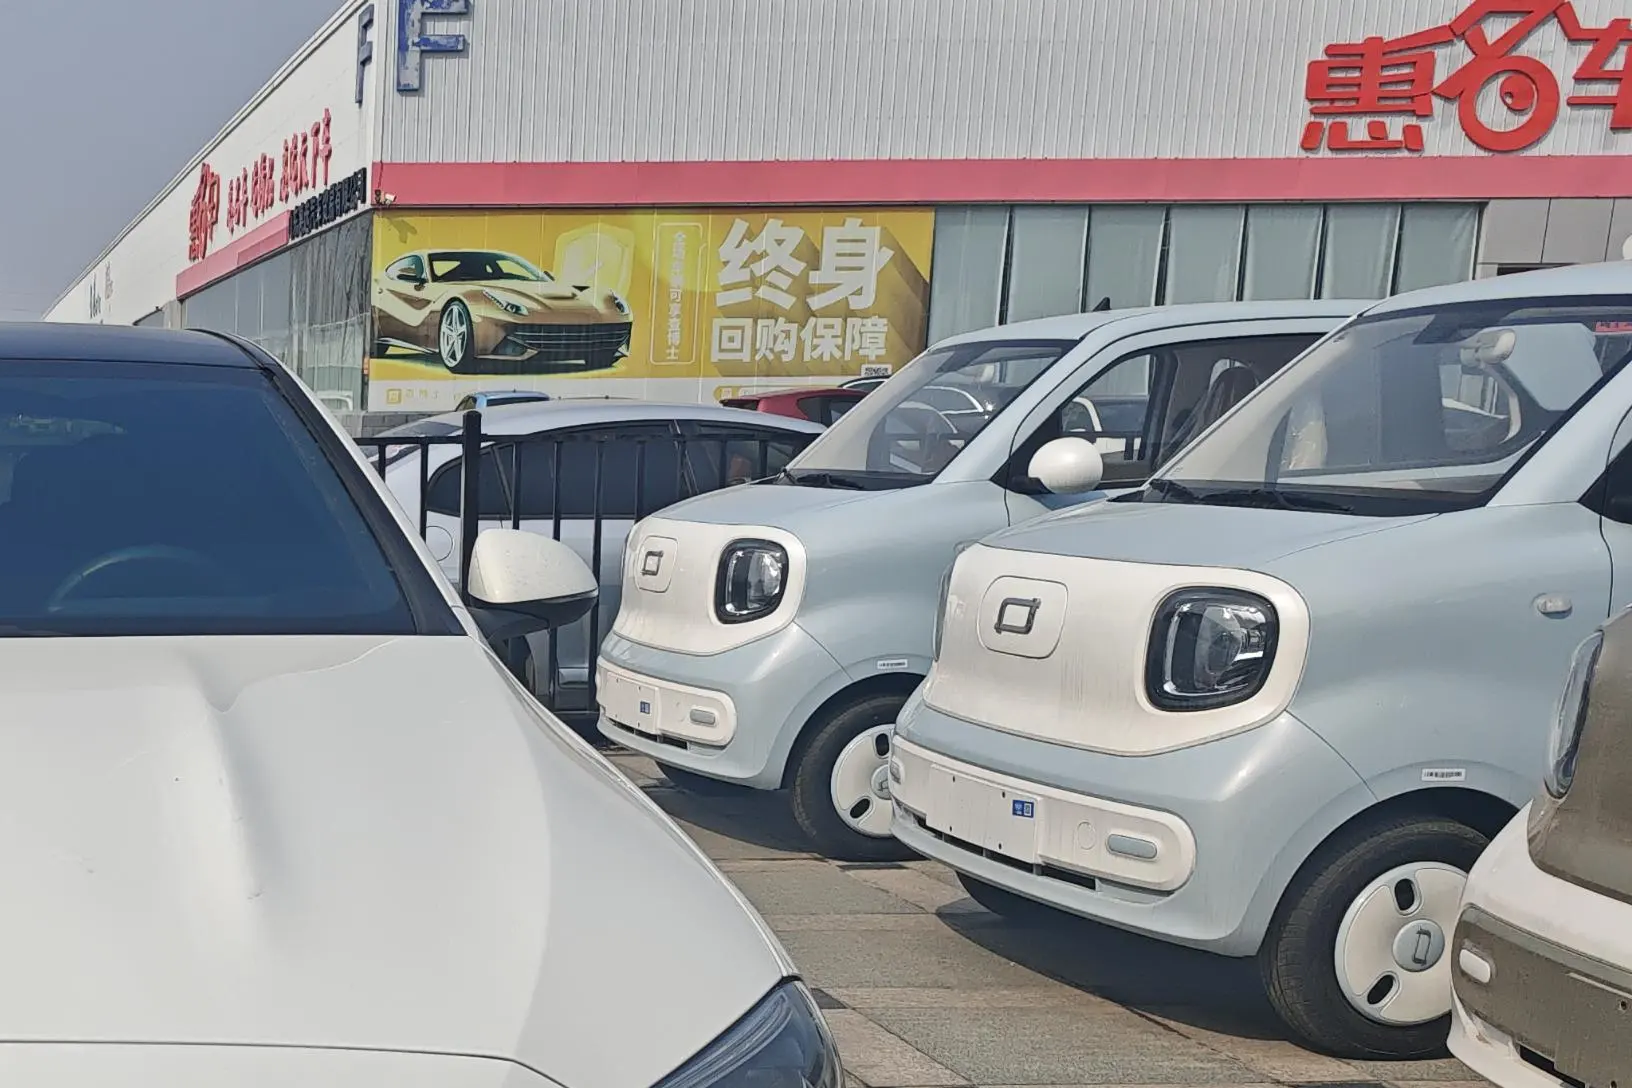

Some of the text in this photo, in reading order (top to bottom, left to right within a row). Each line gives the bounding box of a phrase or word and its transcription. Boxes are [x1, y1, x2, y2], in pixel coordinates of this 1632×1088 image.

[397, 0, 469, 91] F
[715, 218, 894, 311] 终身
[710, 316, 889, 363] 回购保障
